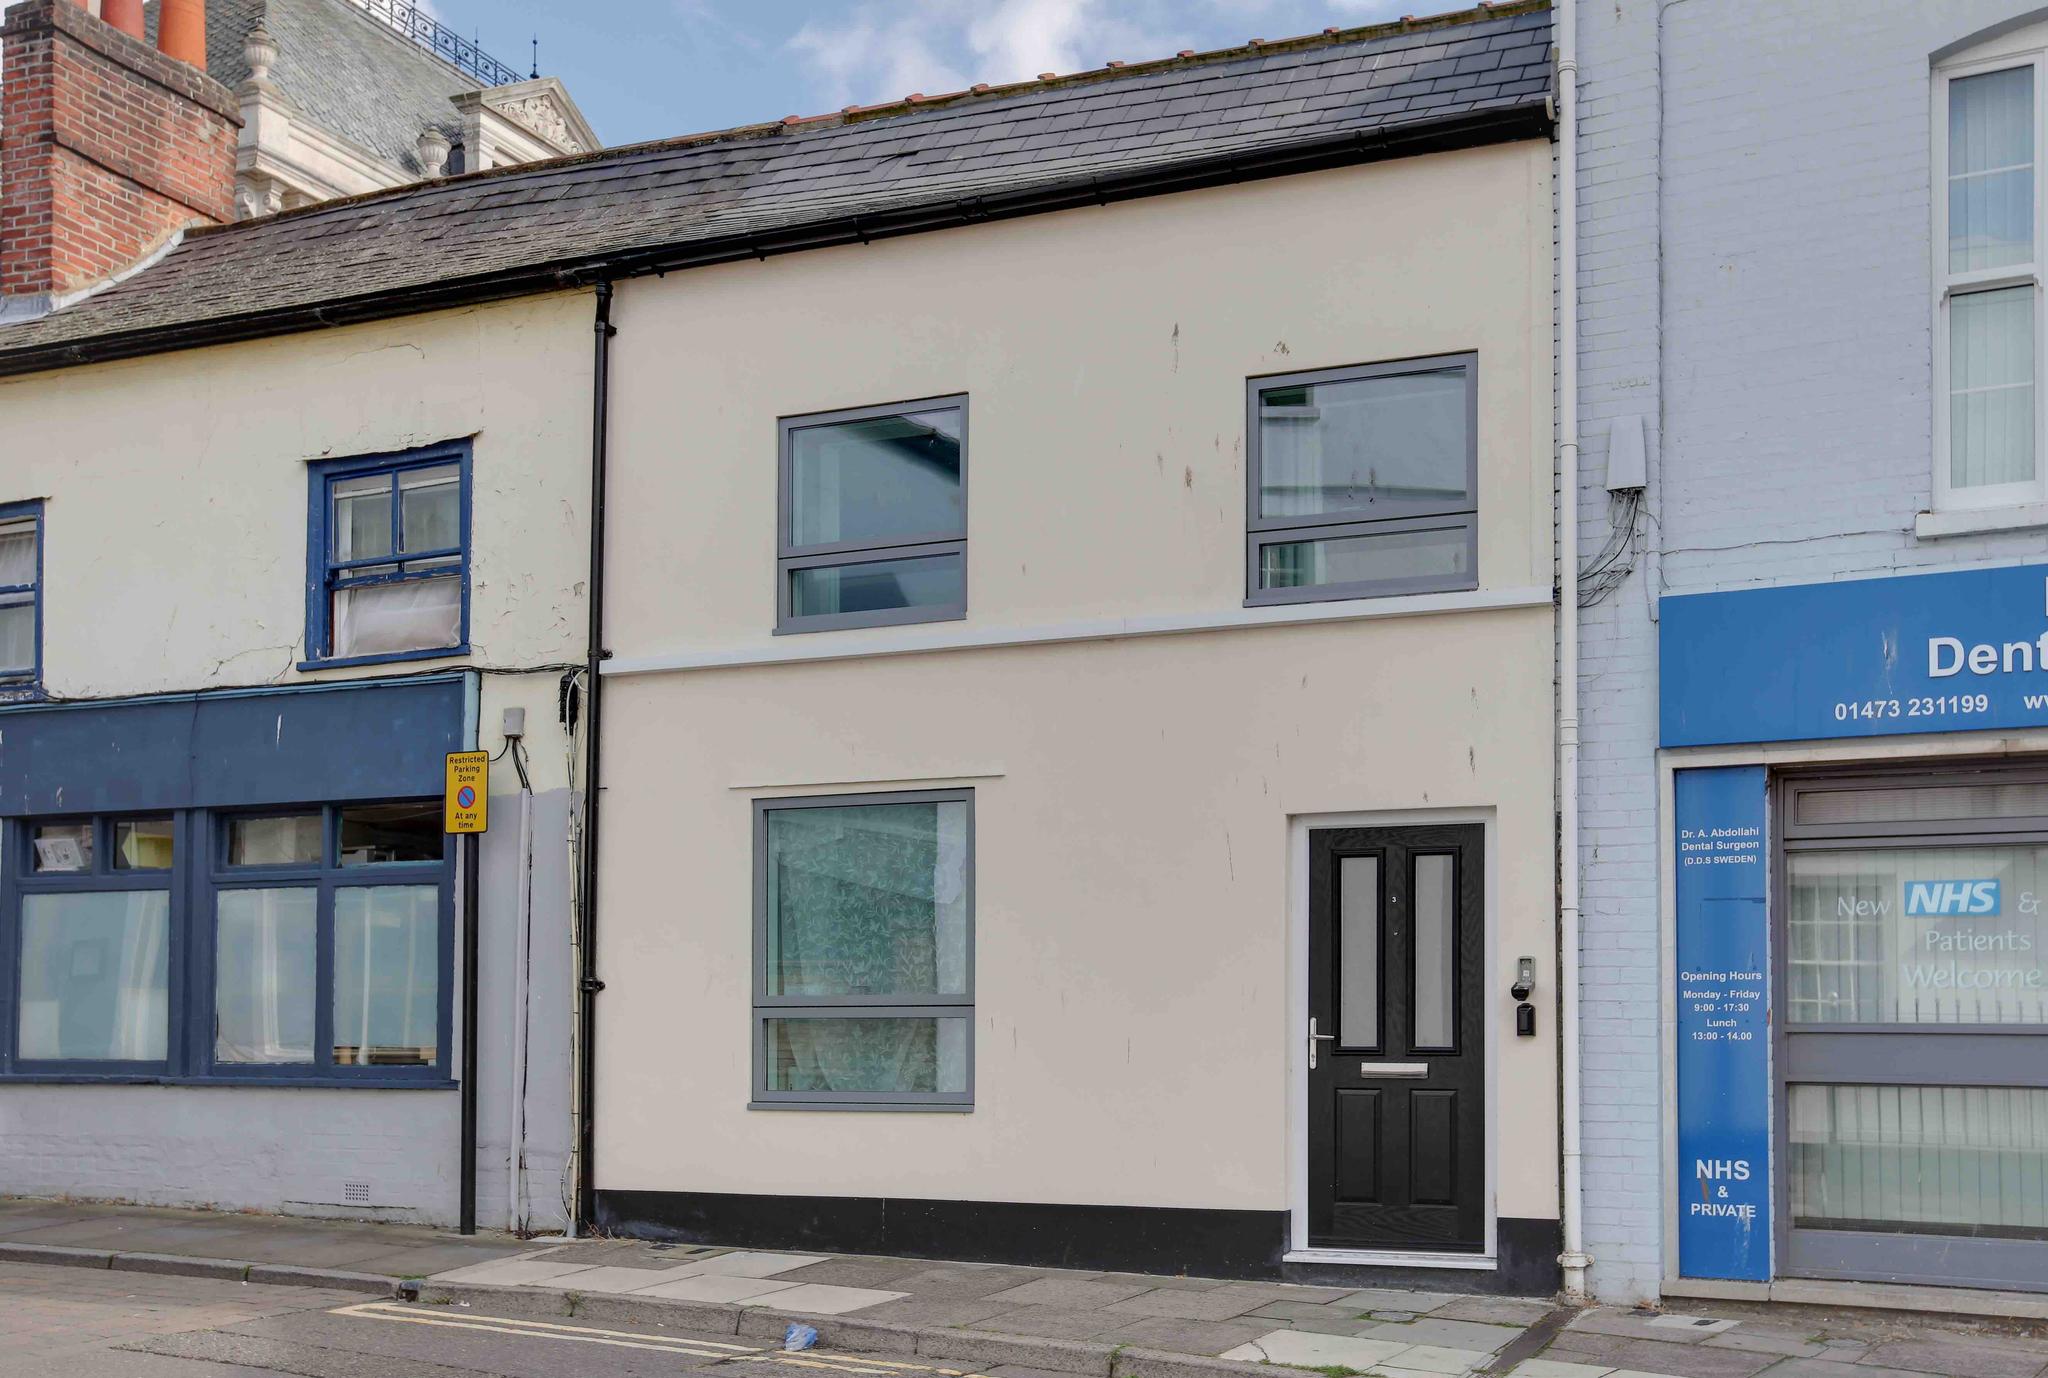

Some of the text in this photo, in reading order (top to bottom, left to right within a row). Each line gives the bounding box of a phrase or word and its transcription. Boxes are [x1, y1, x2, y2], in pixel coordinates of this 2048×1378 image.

[1834, 700, 1900, 720] 01473
[1908, 694, 1989, 716] 231199
[449, 755, 486, 764] Restricted
[454, 765, 480, 774] Parking
[455, 812, 478, 820] At any
[458, 821, 474, 829] time
[1681, 826, 1759, 838] Dr. A. Abdollahi
[1681, 841, 1759, 851] Dental Surgeon
[1684, 855, 1757, 866] (D.D.S SWEDEN)
[1837, 881, 2043, 916] New NHS &
[1925, 929, 2031, 951] Patients
[1681, 971, 1762, 982] Opening Hours
[1904, 960, 2042, 988] Welcome
[1683, 990, 1721, 999] Monday
[1729, 990, 1761, 1000] Friday
[1694, 1003, 1714, 1012] 9:00
[1723, 1003, 1749, 1012] 17:30
[1706, 1019, 1737, 1027] Lunch
[1692, 1032, 1718, 1040] 13:00
[1696, 1159, 1750, 1180] NHS
[1717, 1185, 1729, 1198] &
[1690, 1203, 1756, 1218] PRIVATE
